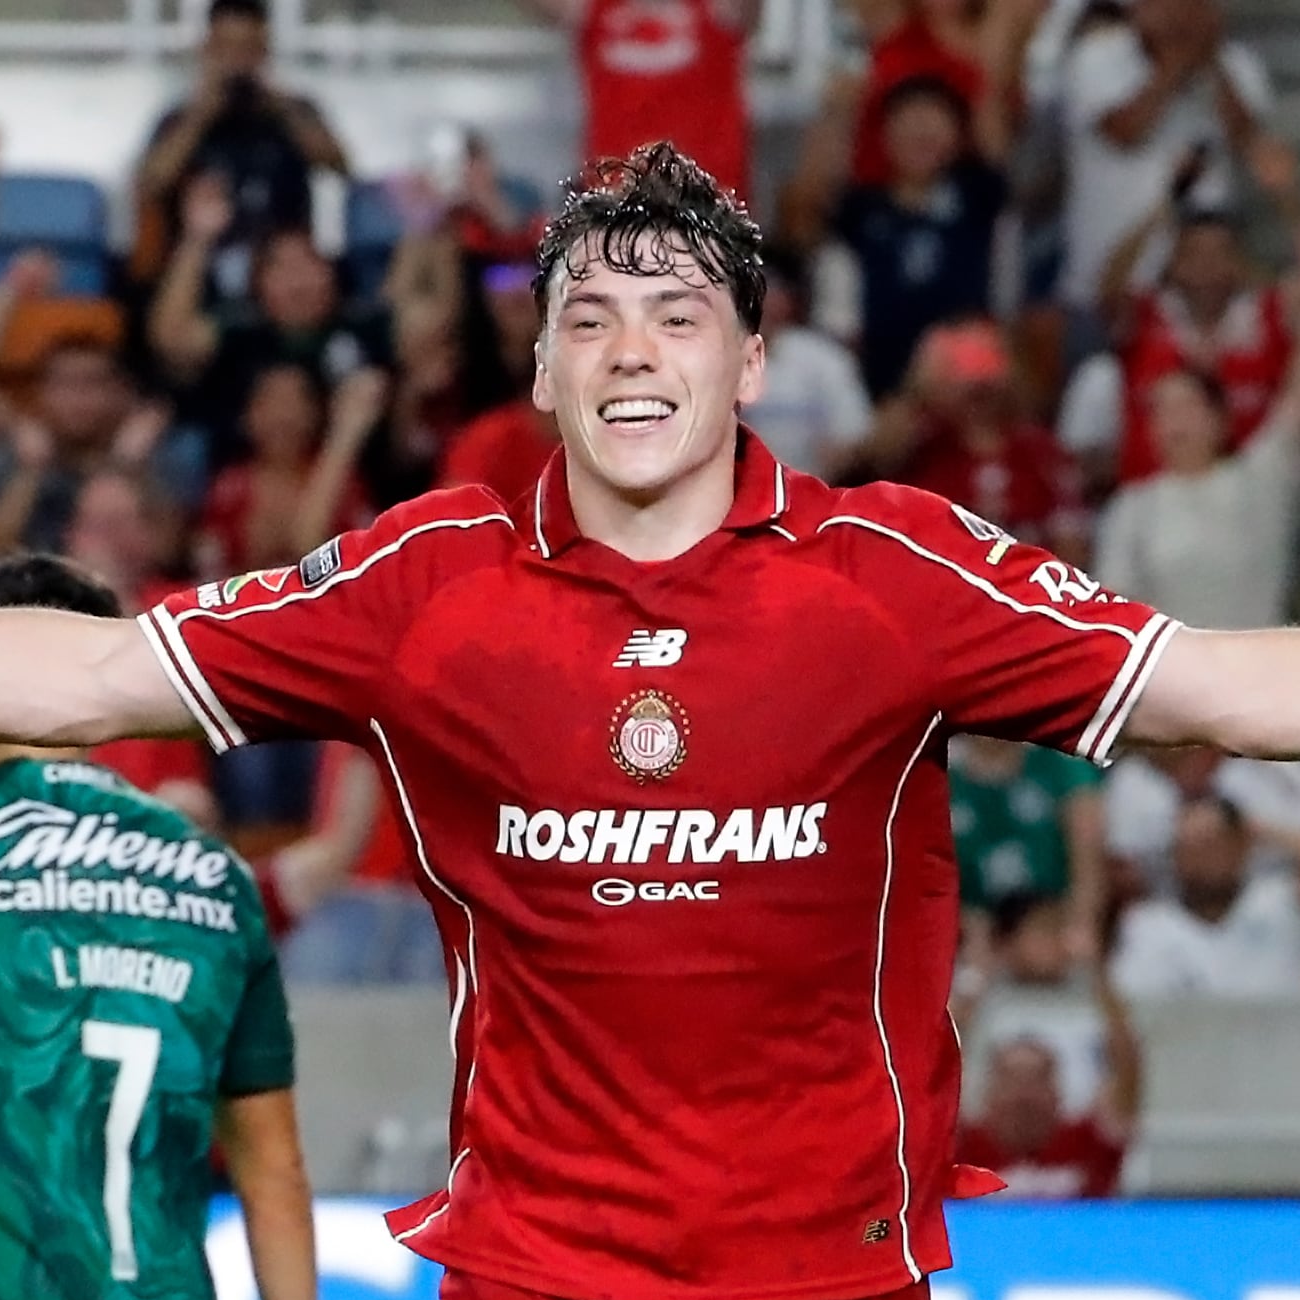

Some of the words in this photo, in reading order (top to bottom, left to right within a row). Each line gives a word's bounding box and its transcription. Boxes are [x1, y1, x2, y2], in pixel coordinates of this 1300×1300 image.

[495, 802, 827, 865] ROSHFRANS
[638, 880, 720, 901] GAC
[78, 944, 192, 1003] MORENO
[81, 1020, 162, 1281] 7
